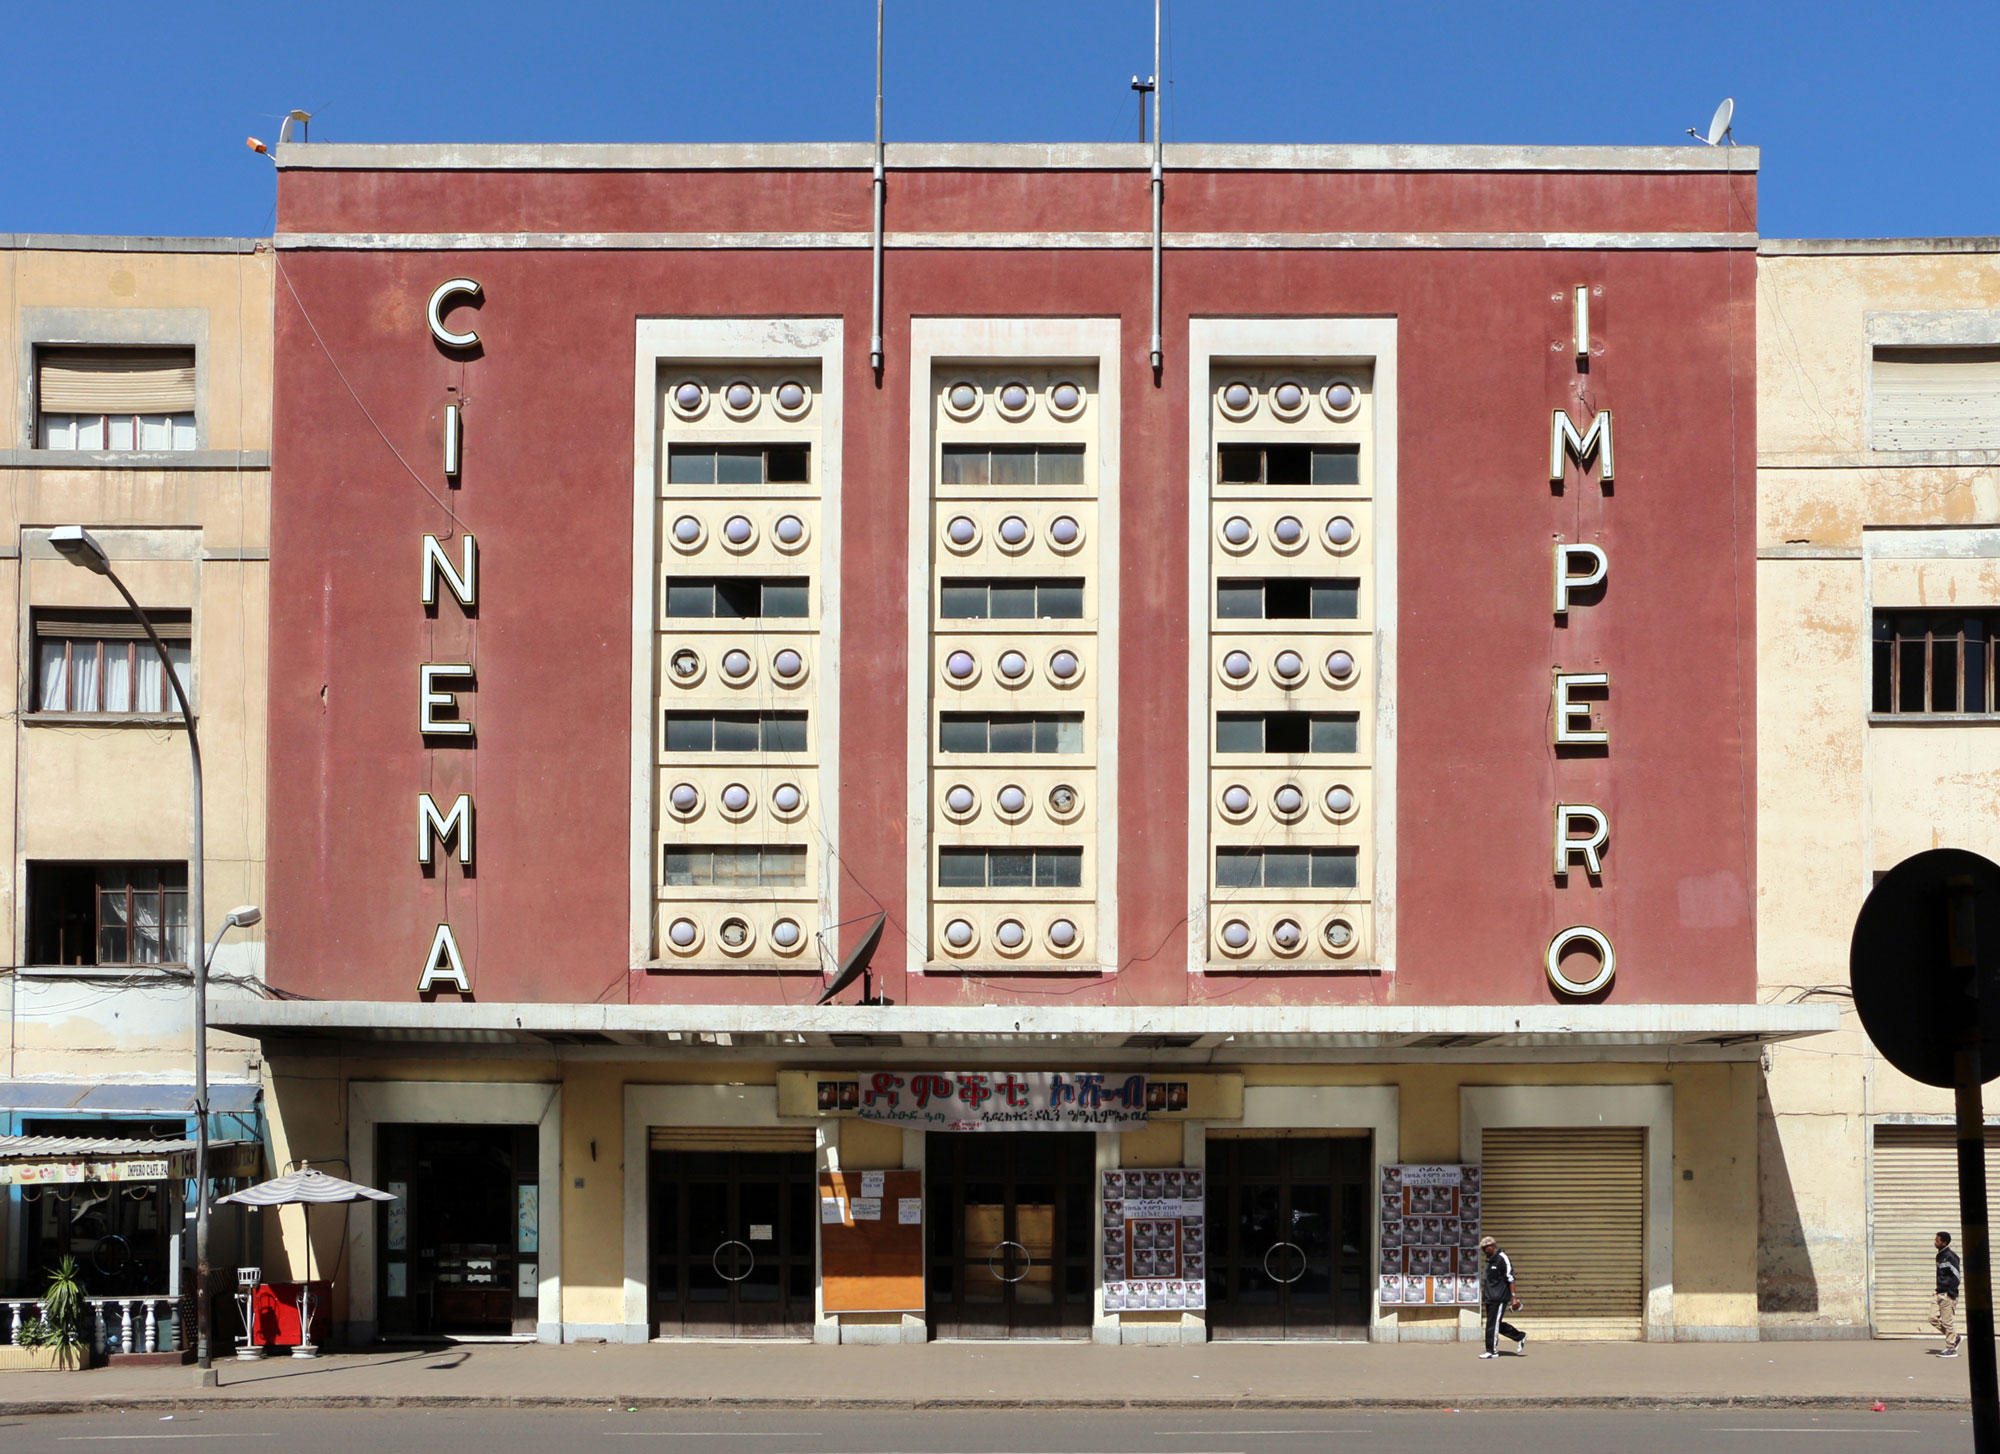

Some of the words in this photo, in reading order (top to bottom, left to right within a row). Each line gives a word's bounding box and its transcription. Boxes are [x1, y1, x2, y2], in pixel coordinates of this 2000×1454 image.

[416, 277, 483, 993] CINEMA
[1544, 284, 1616, 995] IMPERO
[127, 1164, 145, 1177] IMPERO
